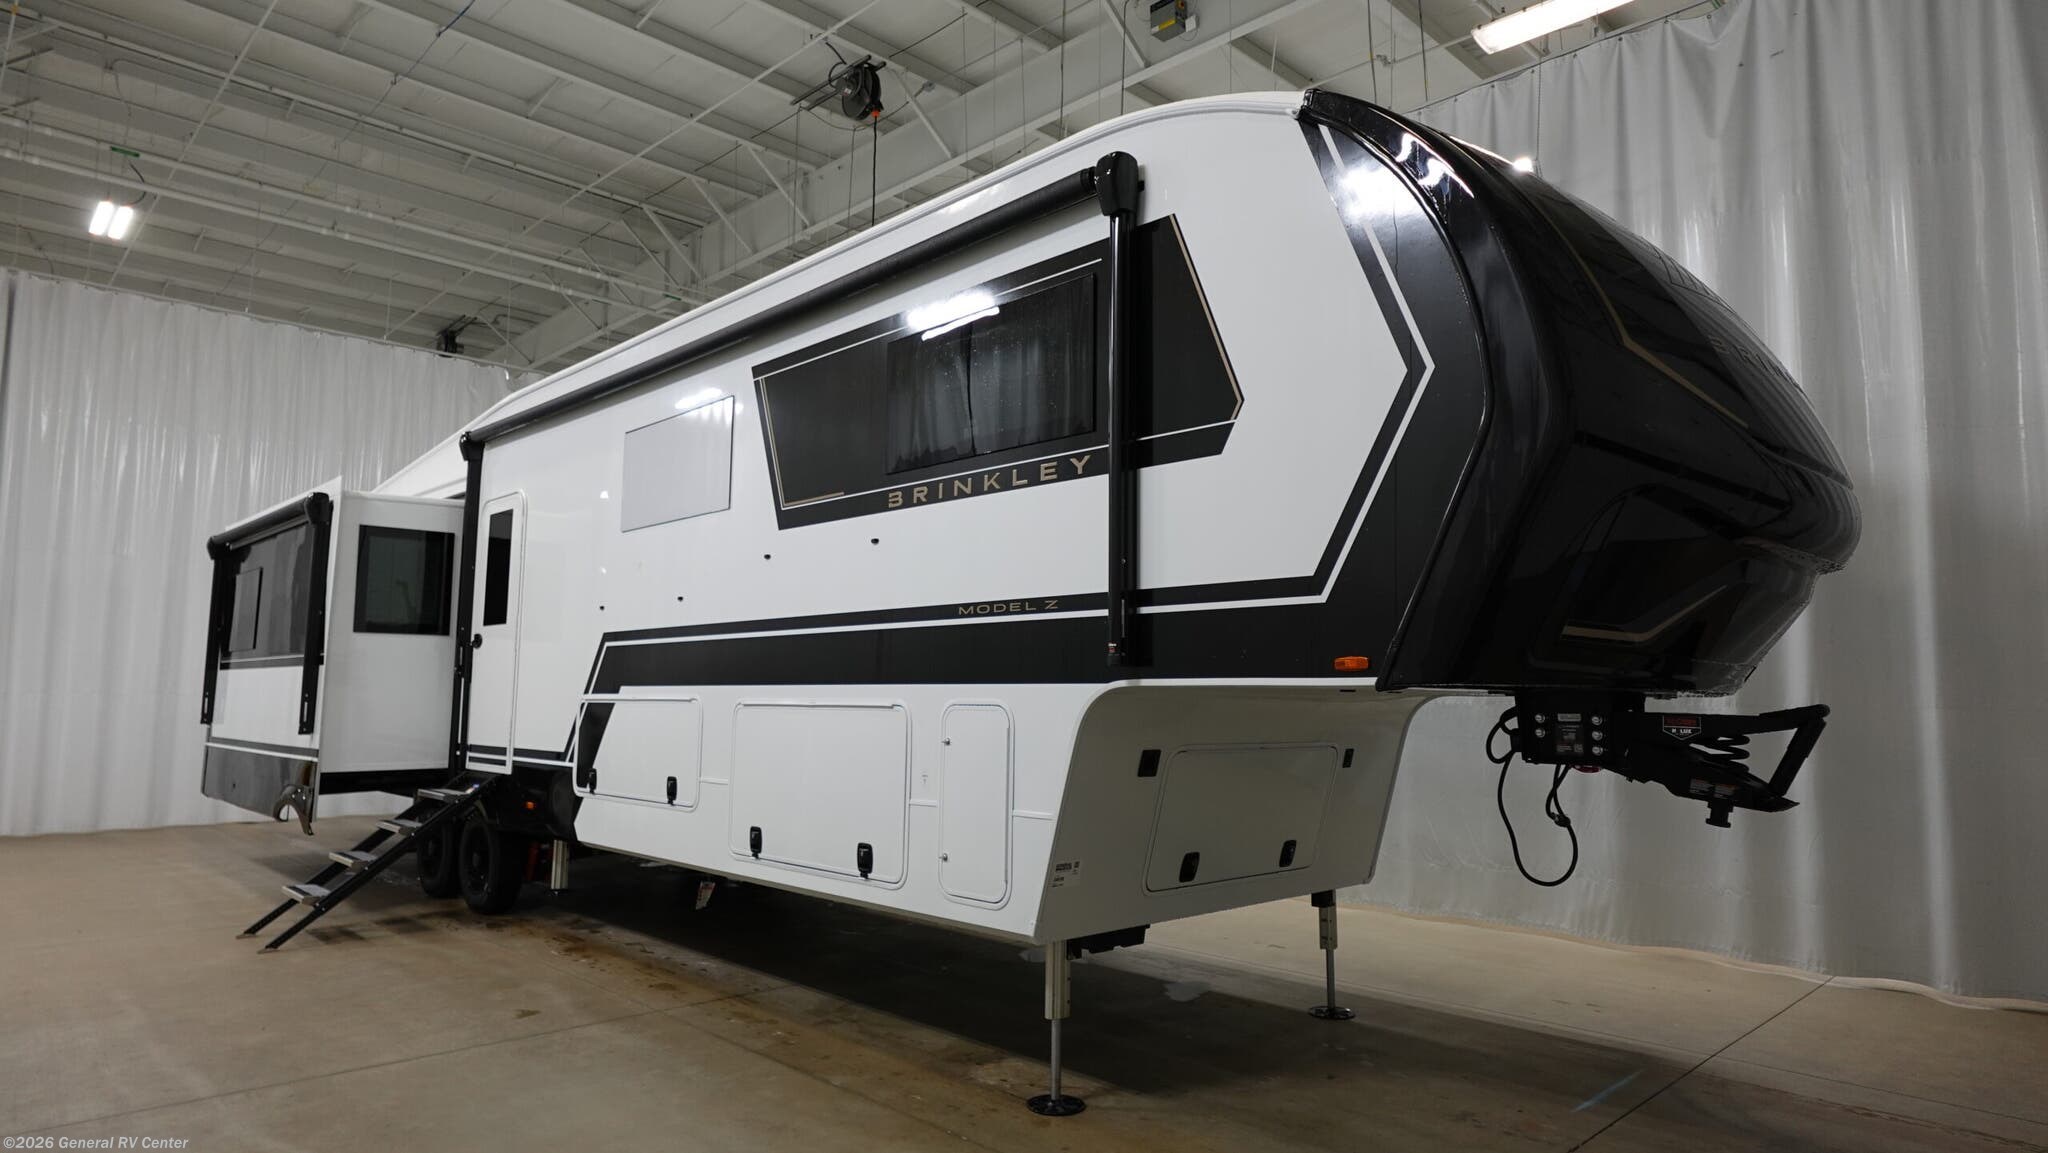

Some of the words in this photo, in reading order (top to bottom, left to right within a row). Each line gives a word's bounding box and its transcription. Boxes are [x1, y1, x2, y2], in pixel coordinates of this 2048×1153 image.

[888, 455, 1091, 508] BRINKLEY
[958, 602, 1037, 616] MODEL
[1044, 600, 1059, 610] Z
